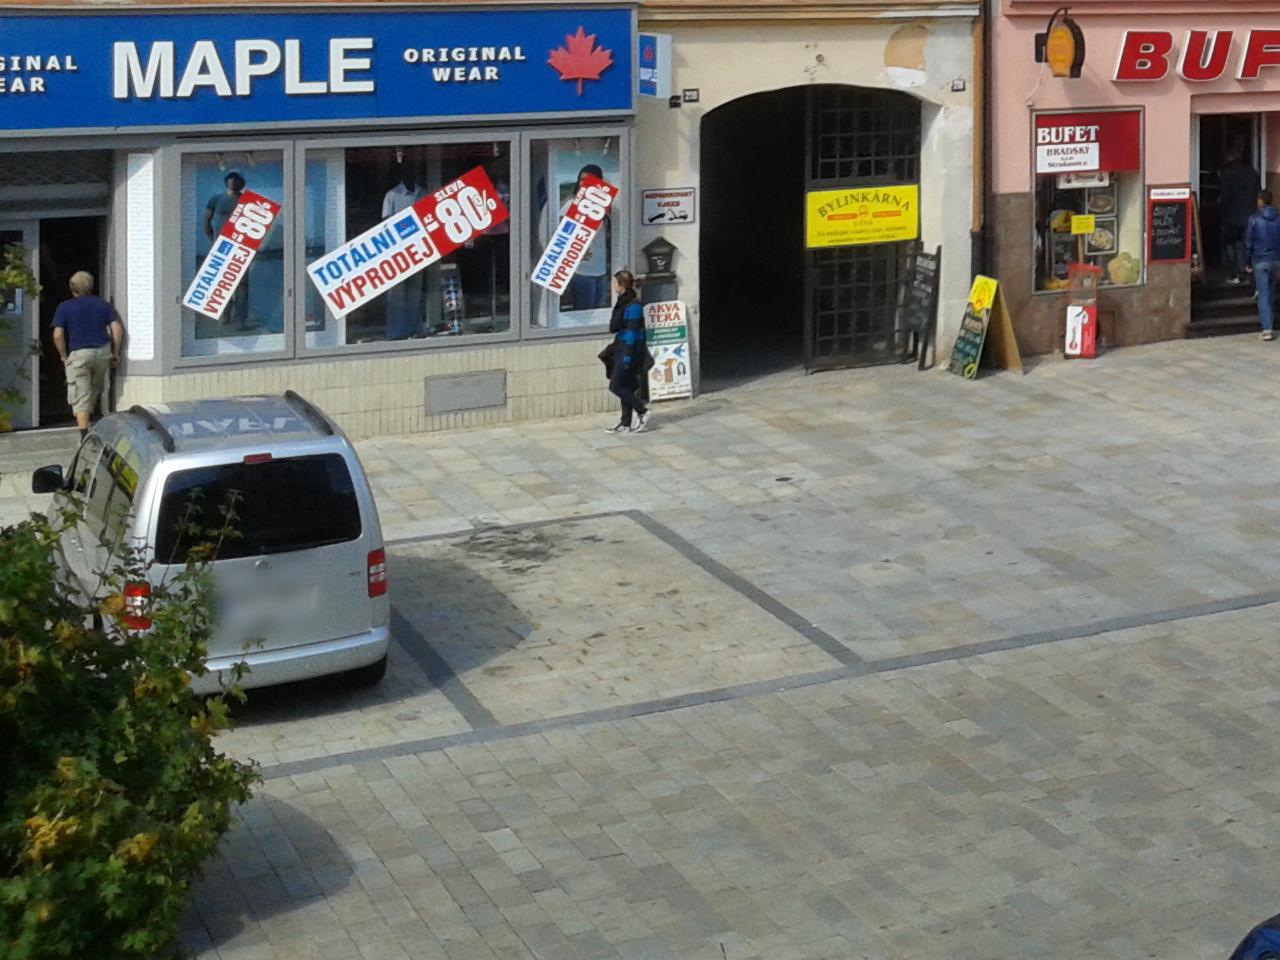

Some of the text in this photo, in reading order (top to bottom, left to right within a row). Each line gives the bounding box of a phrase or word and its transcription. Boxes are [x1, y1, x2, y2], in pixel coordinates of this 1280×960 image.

[403, 46, 526, 62] ORIGINAL
[113, 39, 374, 99] MAPLE
[432, 66, 499, 82] WEAR
[1036, 125, 1099, 144] BUFET
[434, 179, 466, 201] SLEVA
[817, 190, 911, 218] BYLINKÁRNA
[313, 224, 398, 286] TOTÁLNÍ
[327, 236, 435, 311] VÝPRODEJ
